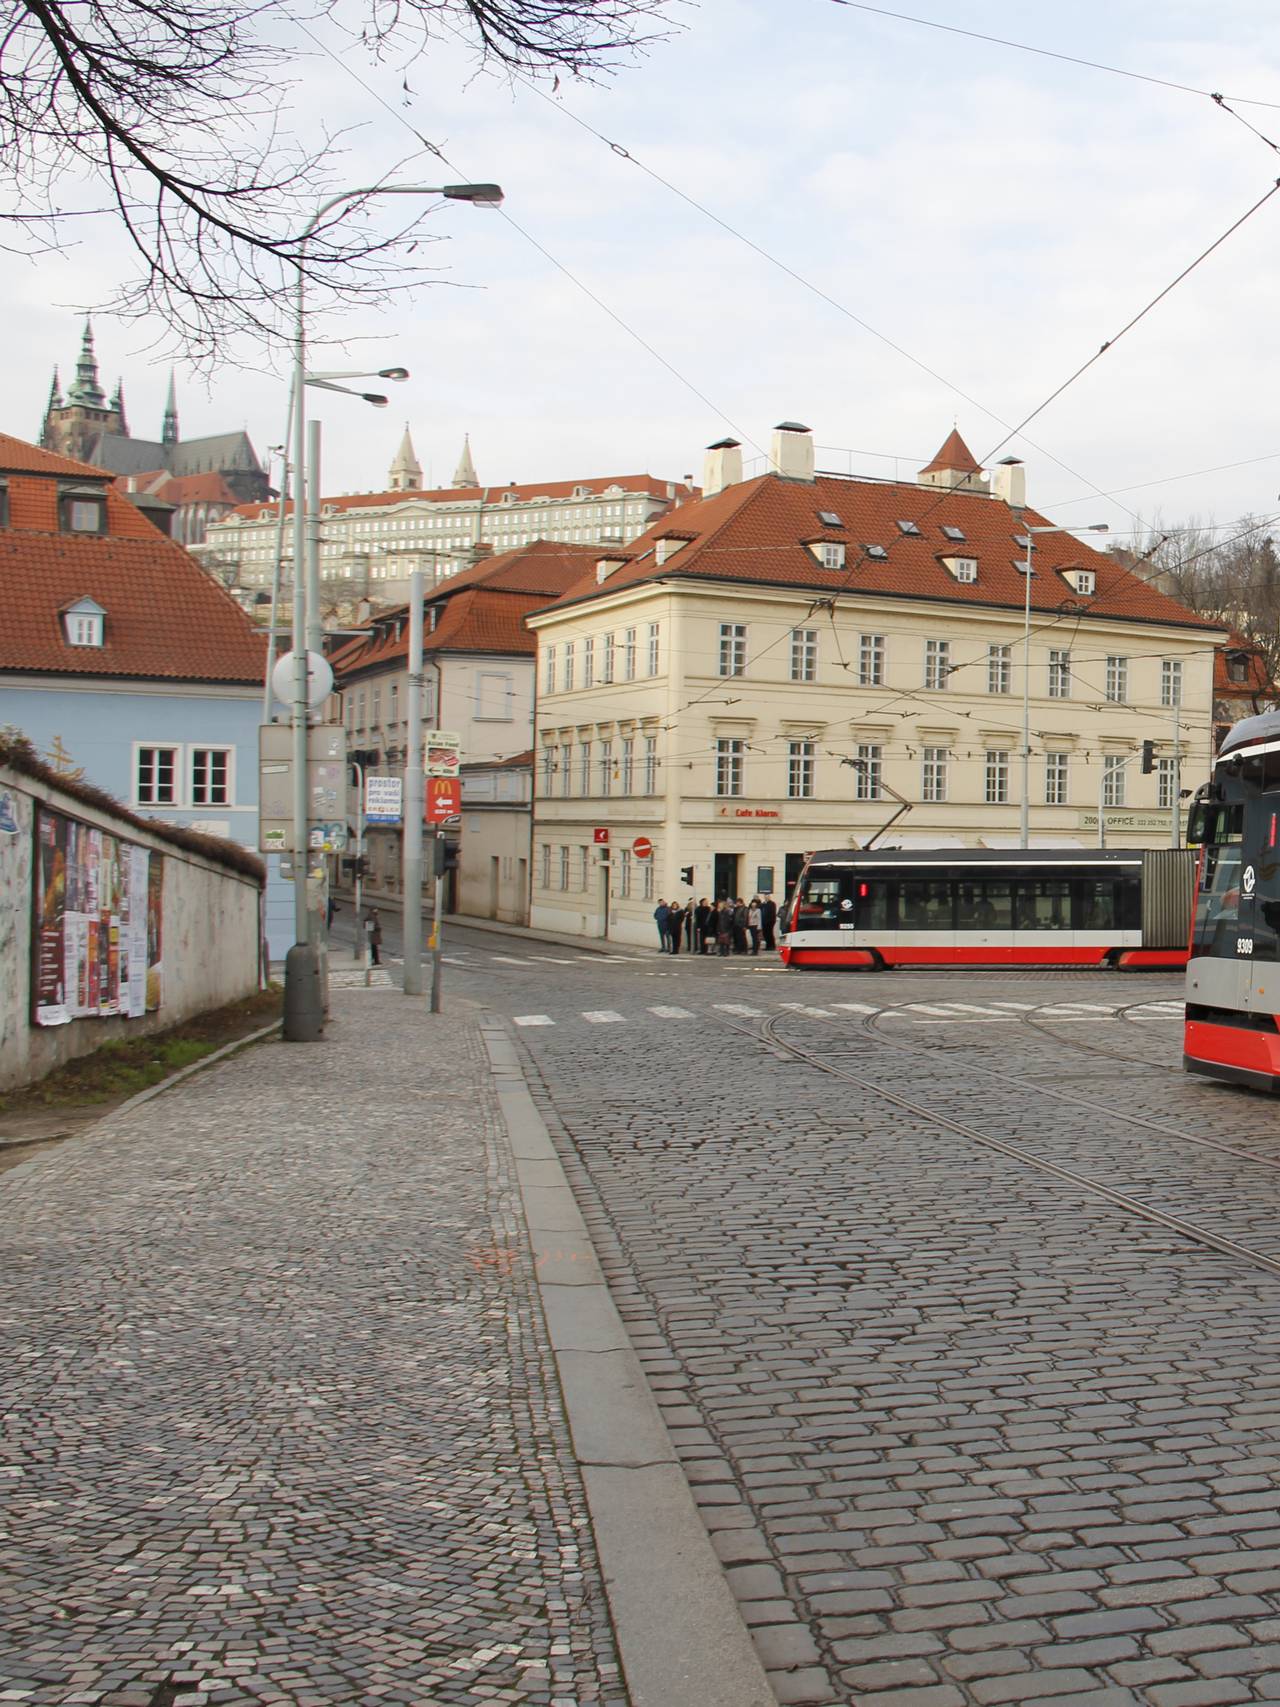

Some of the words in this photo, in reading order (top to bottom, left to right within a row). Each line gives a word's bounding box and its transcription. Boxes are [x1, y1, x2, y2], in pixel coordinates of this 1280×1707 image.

[369, 779, 400, 788] prostor
[1107, 816, 1134, 826] OFFICE
[1237, 938, 1253, 954] 9309
